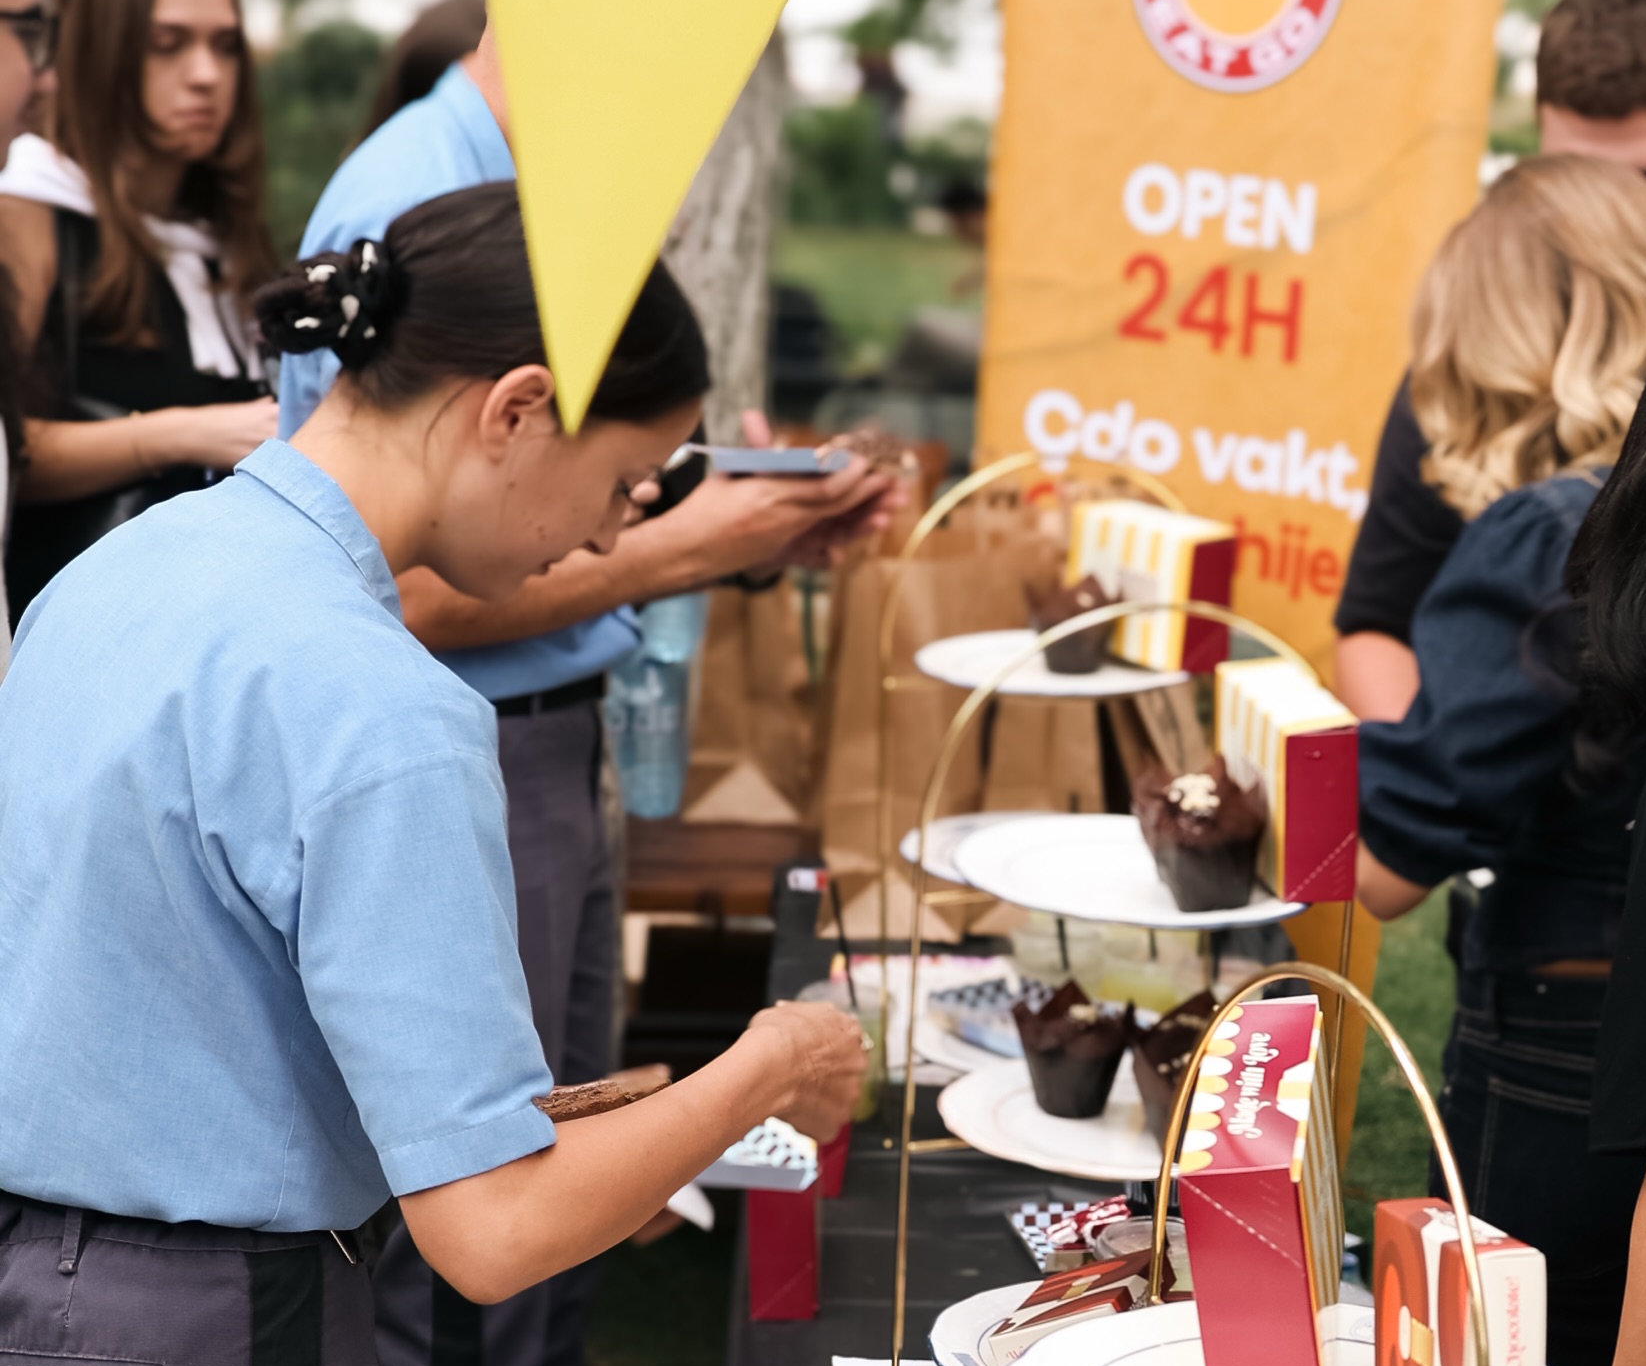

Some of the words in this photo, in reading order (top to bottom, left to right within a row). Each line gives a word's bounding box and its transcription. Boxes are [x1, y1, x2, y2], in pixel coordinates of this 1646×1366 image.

[1122, 162, 1317, 255] OPEN
[1118, 251, 1306, 364] 24H
[1023, 389, 1181, 475] Çdo
[1191, 427, 1369, 521] vakt,
[1232, 513, 1344, 603] hije
